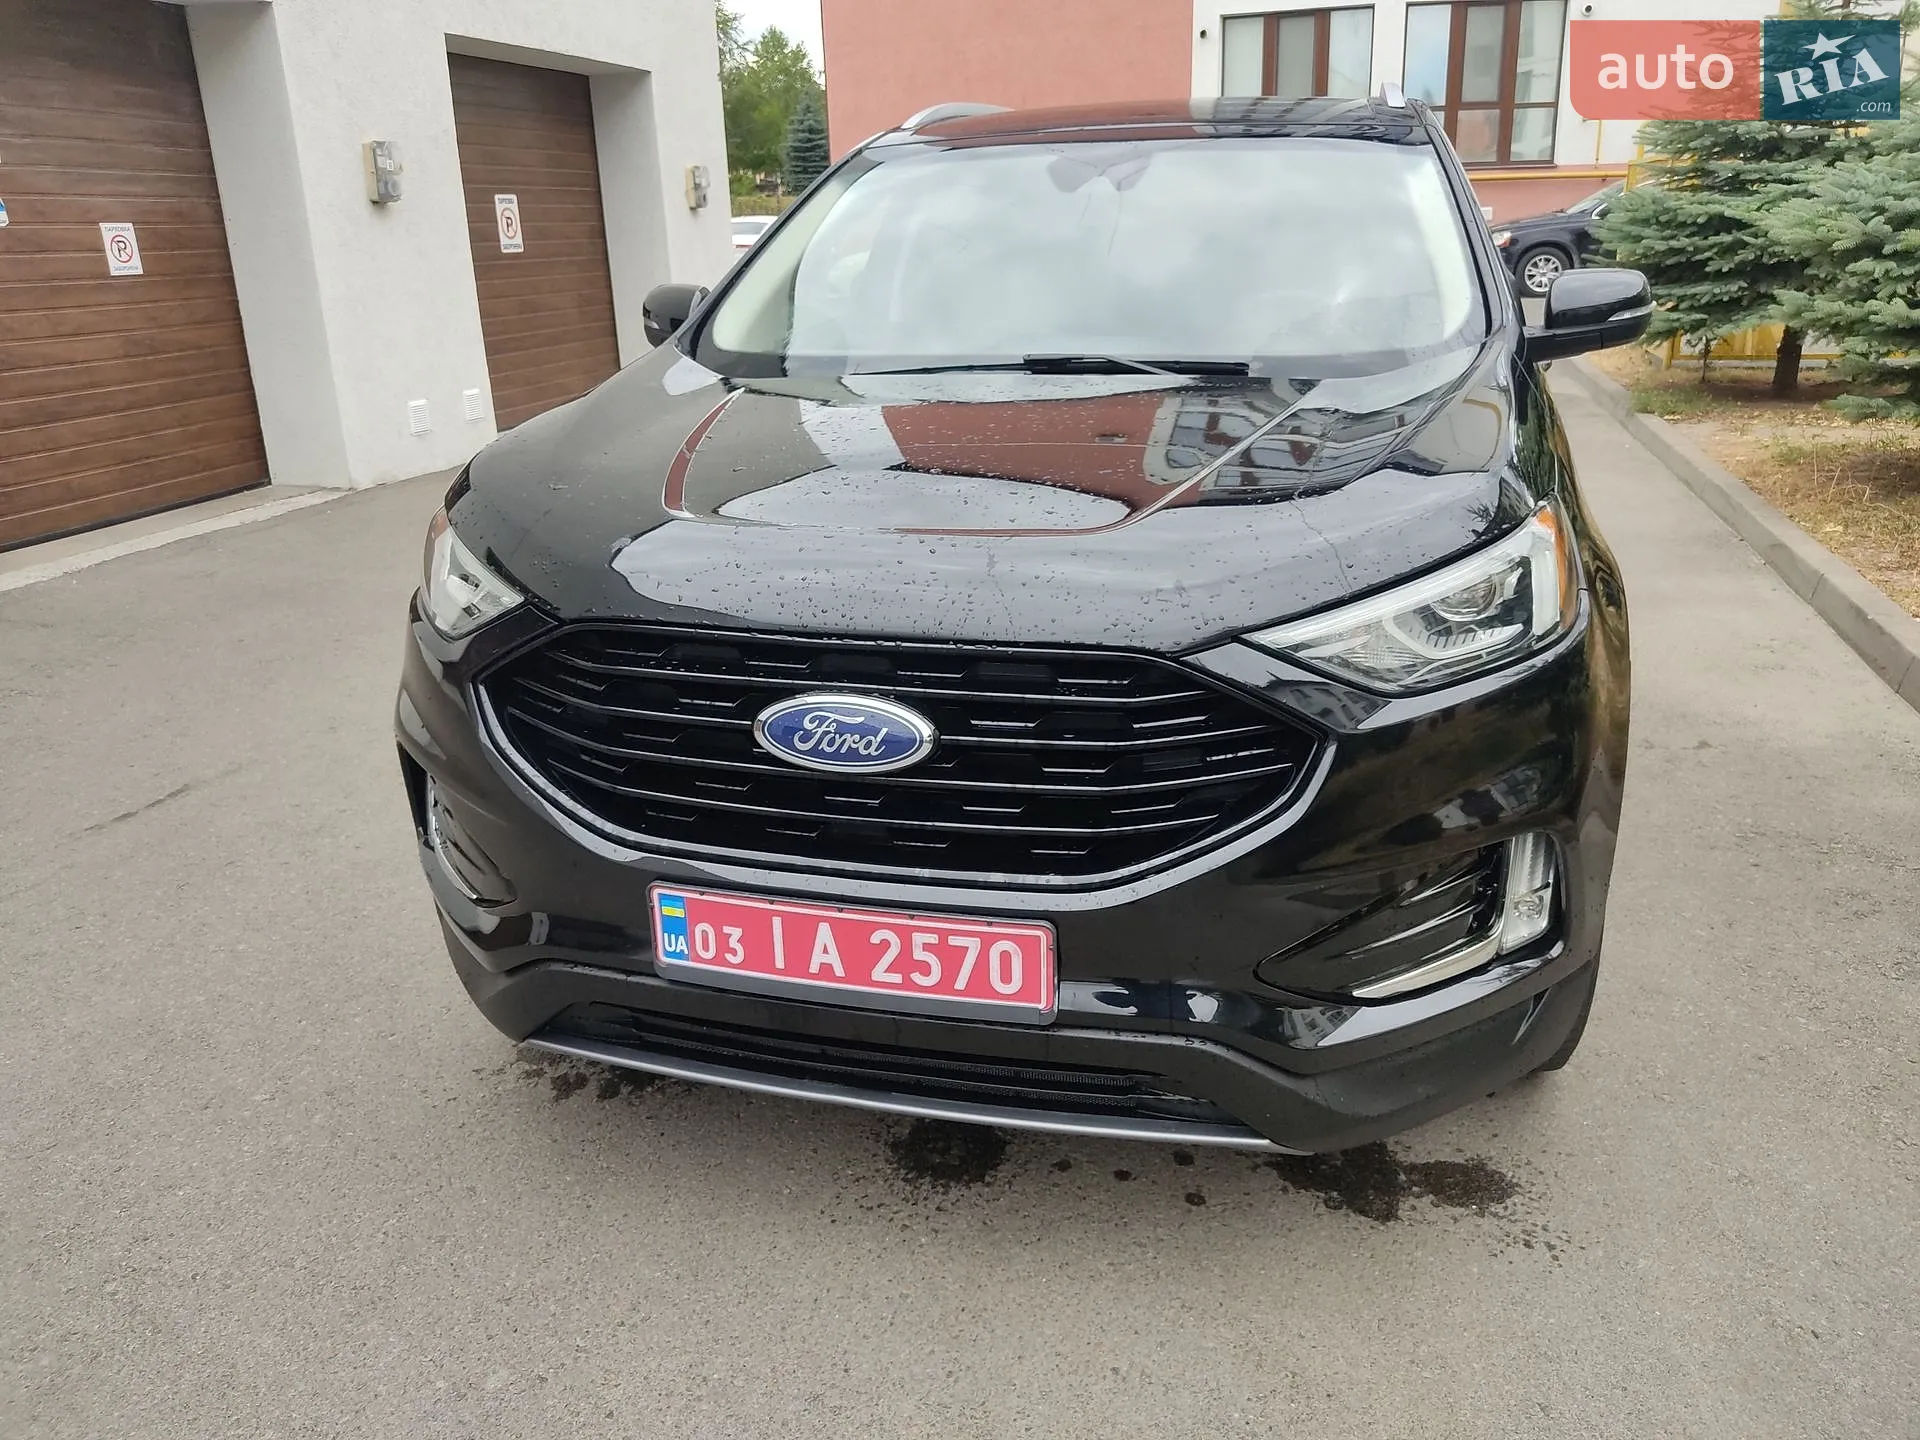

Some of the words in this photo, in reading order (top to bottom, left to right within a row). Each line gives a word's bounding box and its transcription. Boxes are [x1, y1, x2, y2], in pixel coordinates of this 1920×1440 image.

[793, 711, 889, 756] Ford
[663, 932, 689, 954] UA
[694, 922, 746, 965] 03
[869, 928, 1024, 995] 2570
